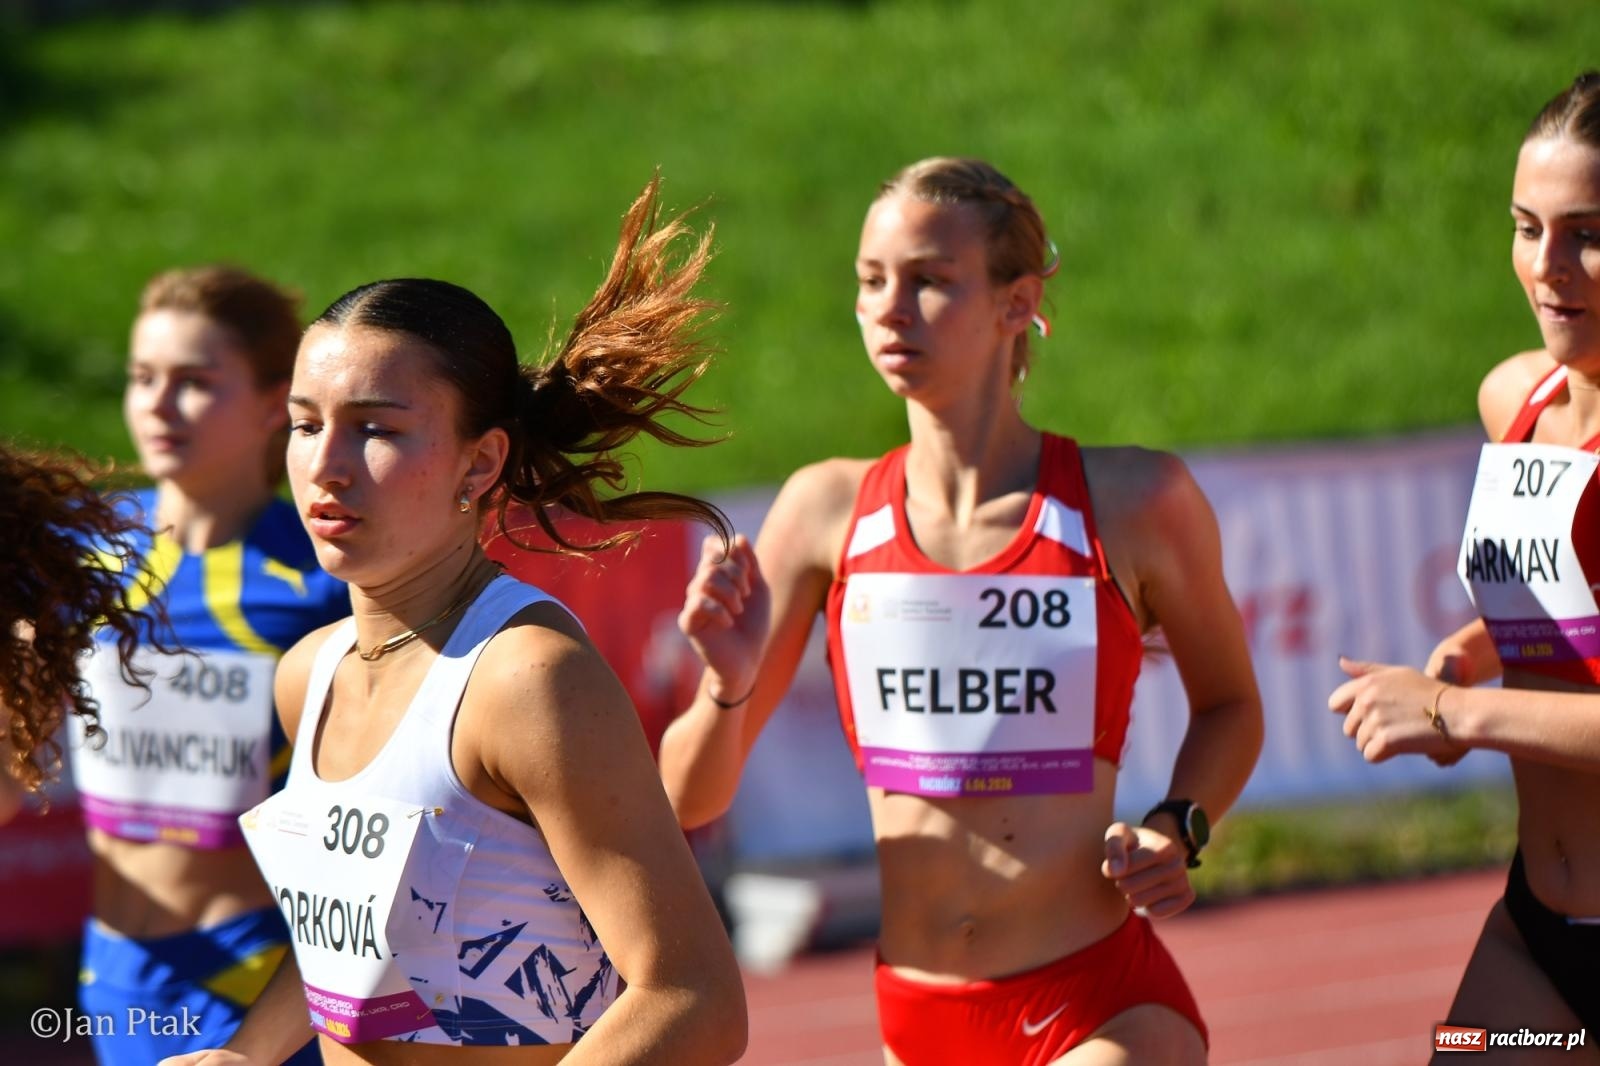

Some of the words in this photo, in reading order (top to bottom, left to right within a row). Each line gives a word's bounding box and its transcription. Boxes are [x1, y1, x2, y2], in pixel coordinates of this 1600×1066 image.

[1512, 458, 1572, 497] 207
[978, 588, 1071, 629] 208
[169, 664, 250, 702] 408
[876, 668, 1058, 715] FELBER
[323, 804, 389, 859] 308
[275, 886, 382, 961] ORKOVÁ
